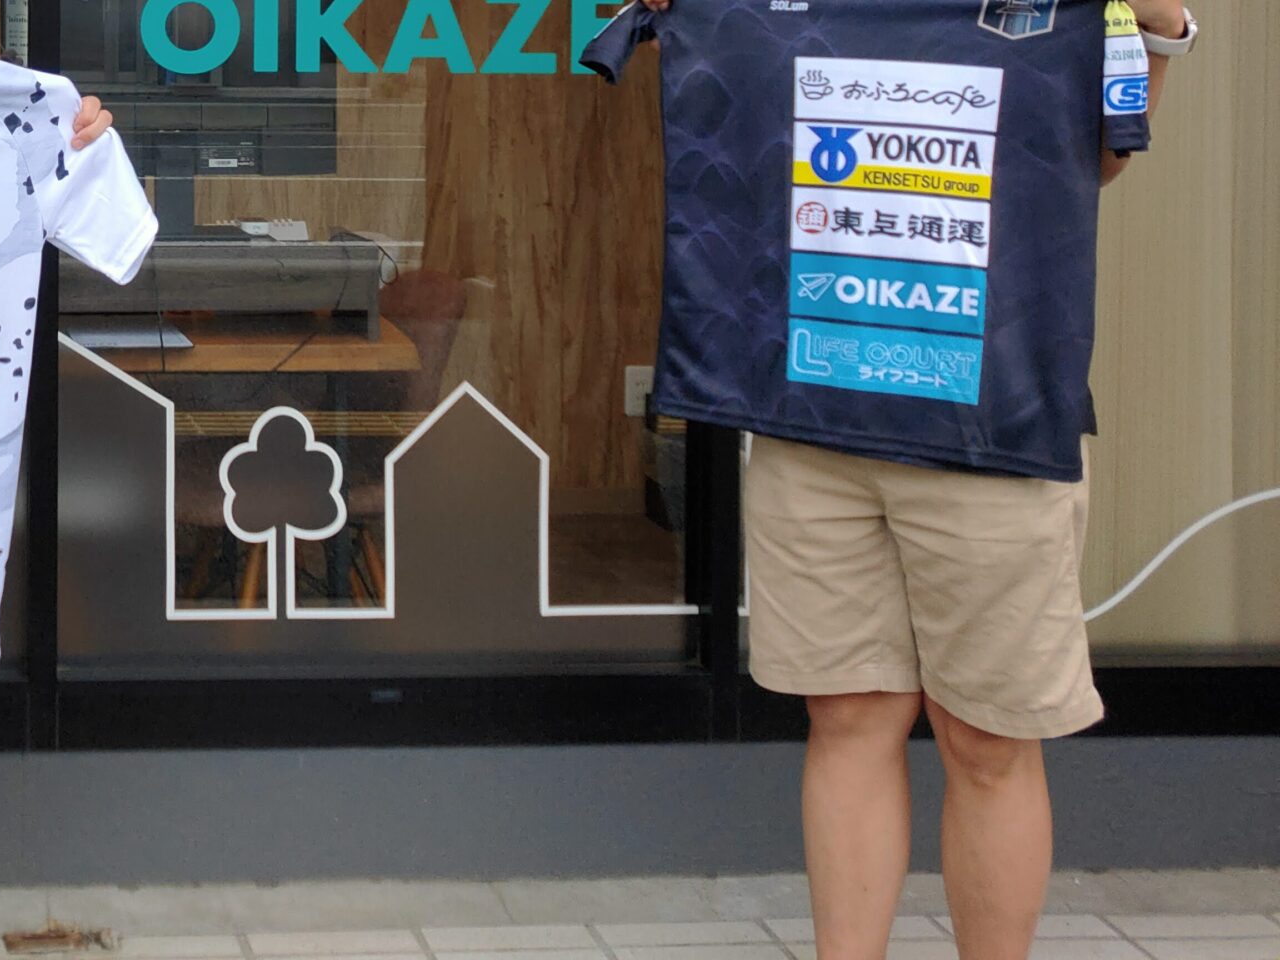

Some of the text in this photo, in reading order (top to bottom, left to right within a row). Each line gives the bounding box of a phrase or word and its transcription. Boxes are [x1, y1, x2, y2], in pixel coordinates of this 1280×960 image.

[866, 131, 982, 170] YOKOTA
[862, 170, 981, 194] KENSETSU group
[834, 275, 980, 317] OIKAZE
[793, 328, 977, 377] LIFE COURT
[858, 365, 949, 388] ライフコート
